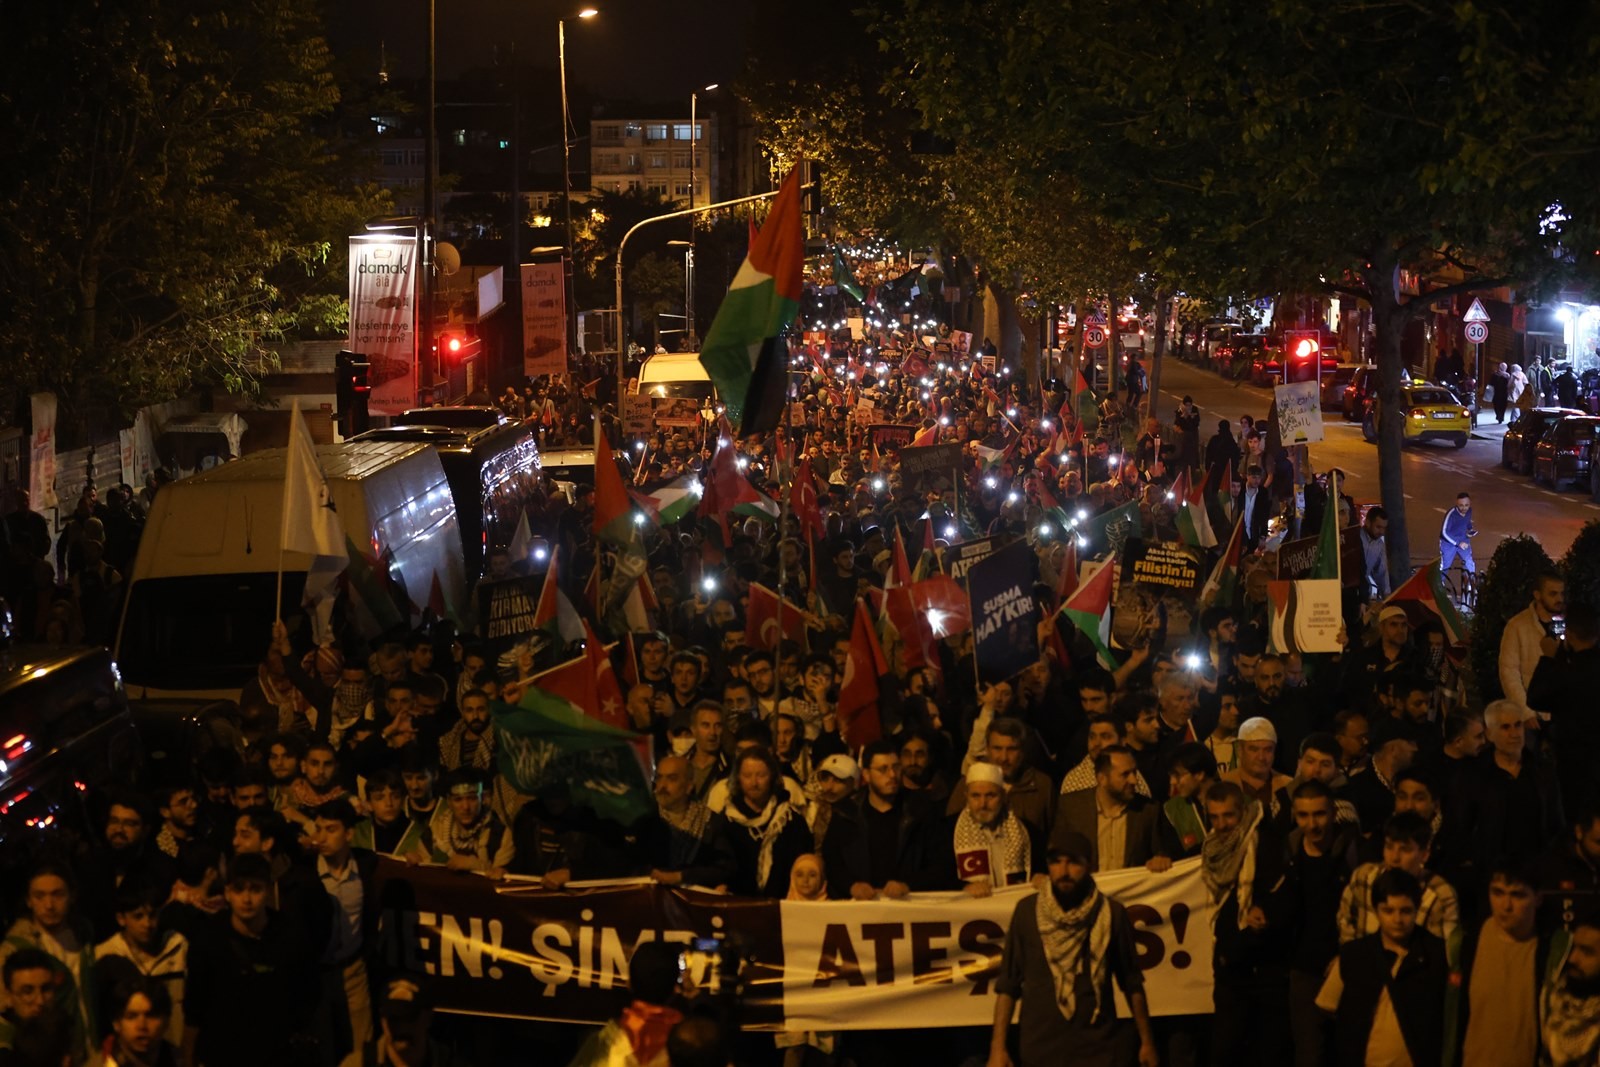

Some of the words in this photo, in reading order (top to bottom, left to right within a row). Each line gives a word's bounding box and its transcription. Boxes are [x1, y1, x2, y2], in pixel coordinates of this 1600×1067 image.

[358, 254, 407, 274] damak
[526, 273, 557, 288] damak
[1088, 331, 1102, 342] 30
[1470, 326, 1483, 337] 30
[1134, 560, 1197, 579] Filistin'in
[983, 584, 1022, 615] SUSMA
[976, 595, 1034, 645] HAYKIR!
